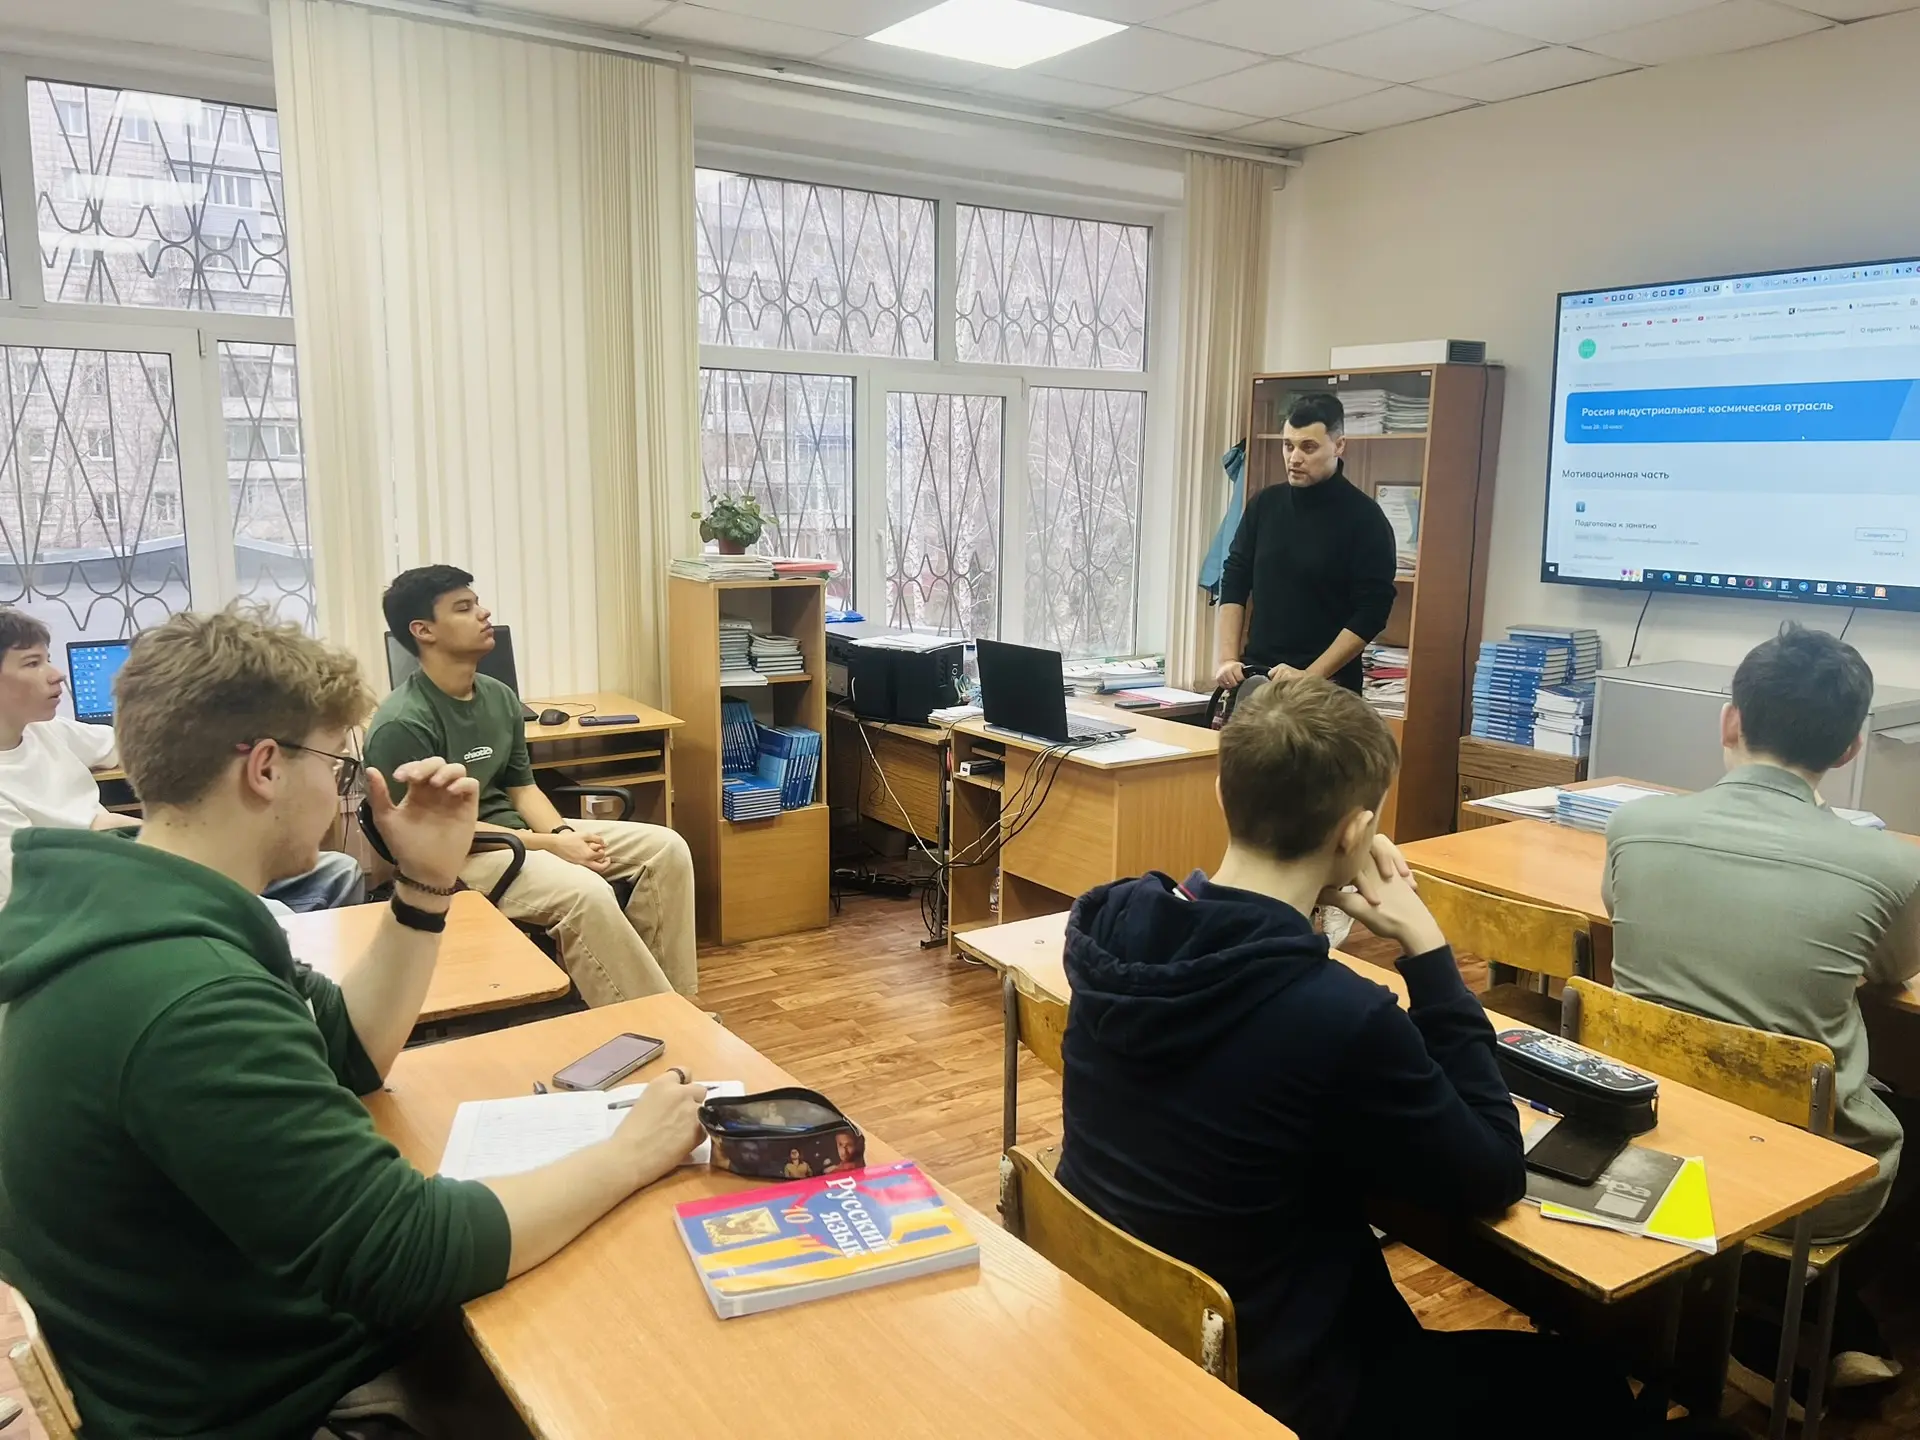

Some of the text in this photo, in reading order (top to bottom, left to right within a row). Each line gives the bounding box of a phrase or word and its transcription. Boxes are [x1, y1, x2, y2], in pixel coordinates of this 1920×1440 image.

[1581, 401, 1834, 419] Россия индустриальная: космическая отрасль
[1562, 469, 1670, 480] Мотивационная часть
[1574, 519, 1617, 528] Подготовка
[1625, 522, 1657, 530] занятию
[780, 1205, 814, 1224] 10
[825, 1176, 899, 1255] Русский
[819, 1212, 866, 1258] язык
